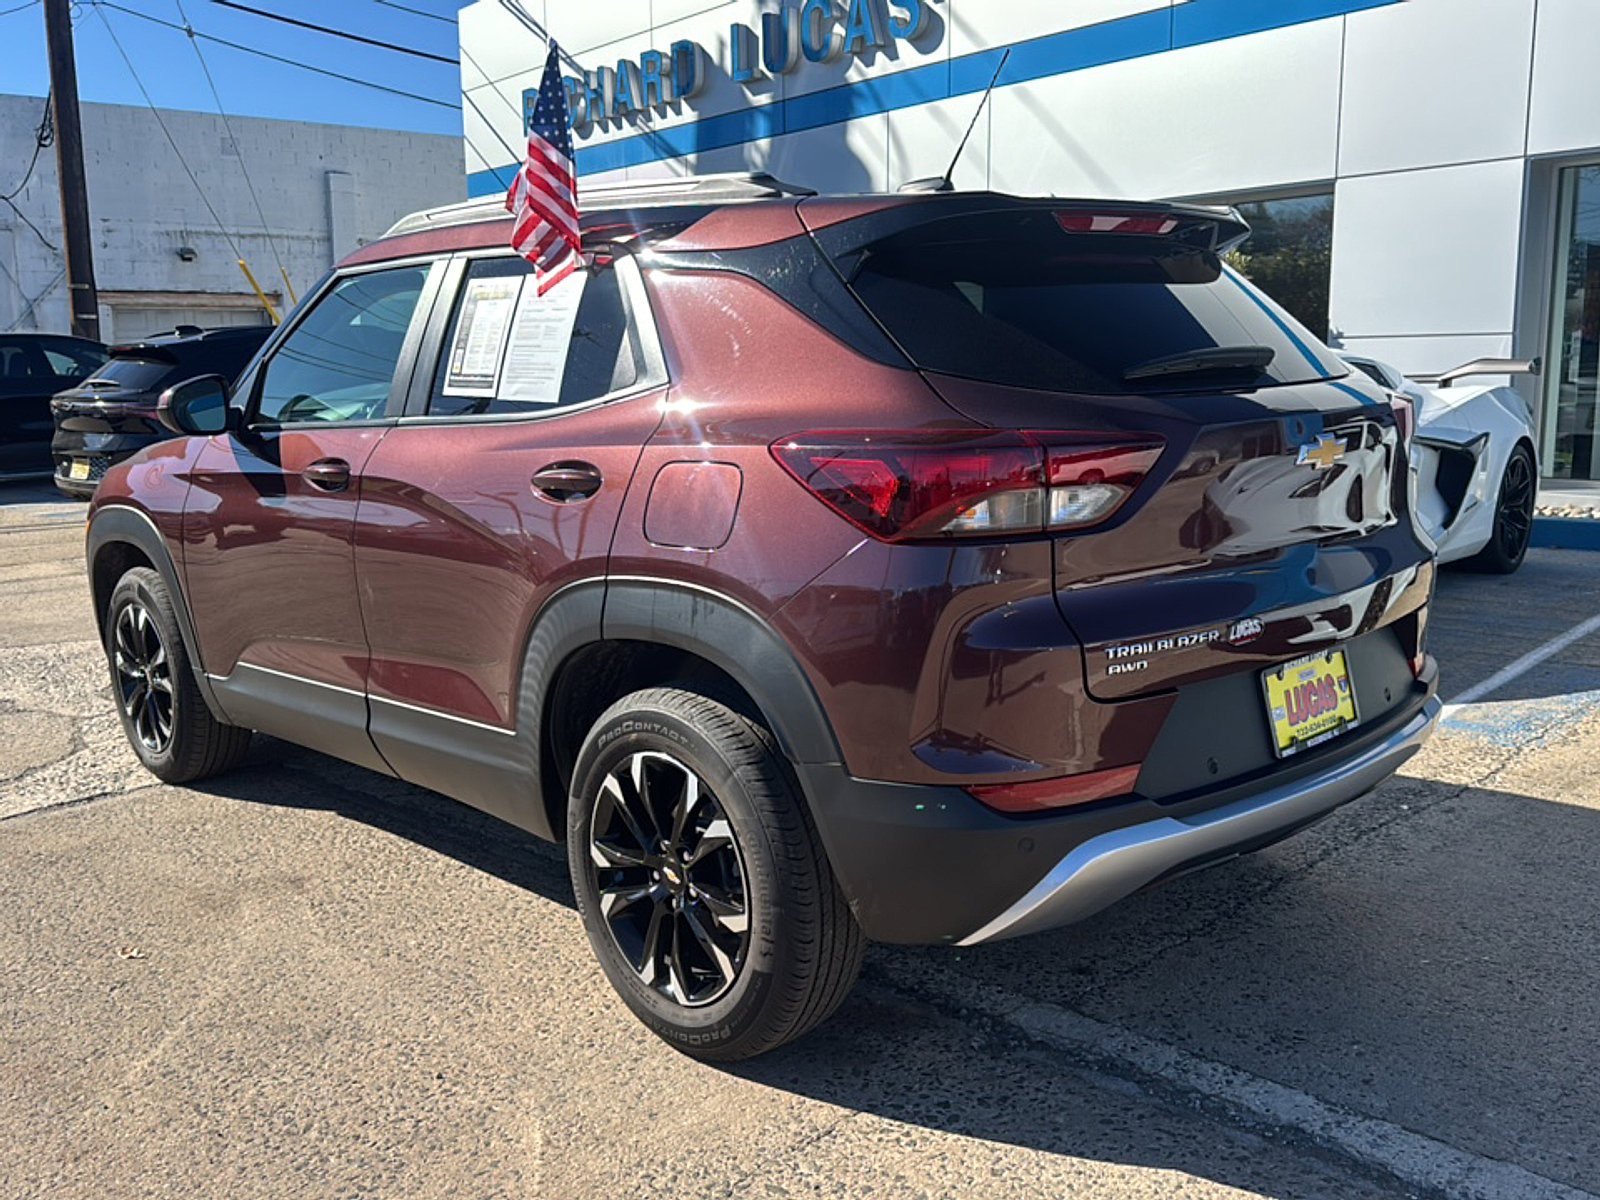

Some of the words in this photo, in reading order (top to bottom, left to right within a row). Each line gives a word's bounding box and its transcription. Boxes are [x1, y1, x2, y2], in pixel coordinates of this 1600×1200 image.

[731, 0, 923, 81] LUCAS
[1105, 630, 1219, 660] TRAILBLAZER
[1108, 660, 1148, 675] AWD
[1284, 674, 1337, 726] LUCAS
